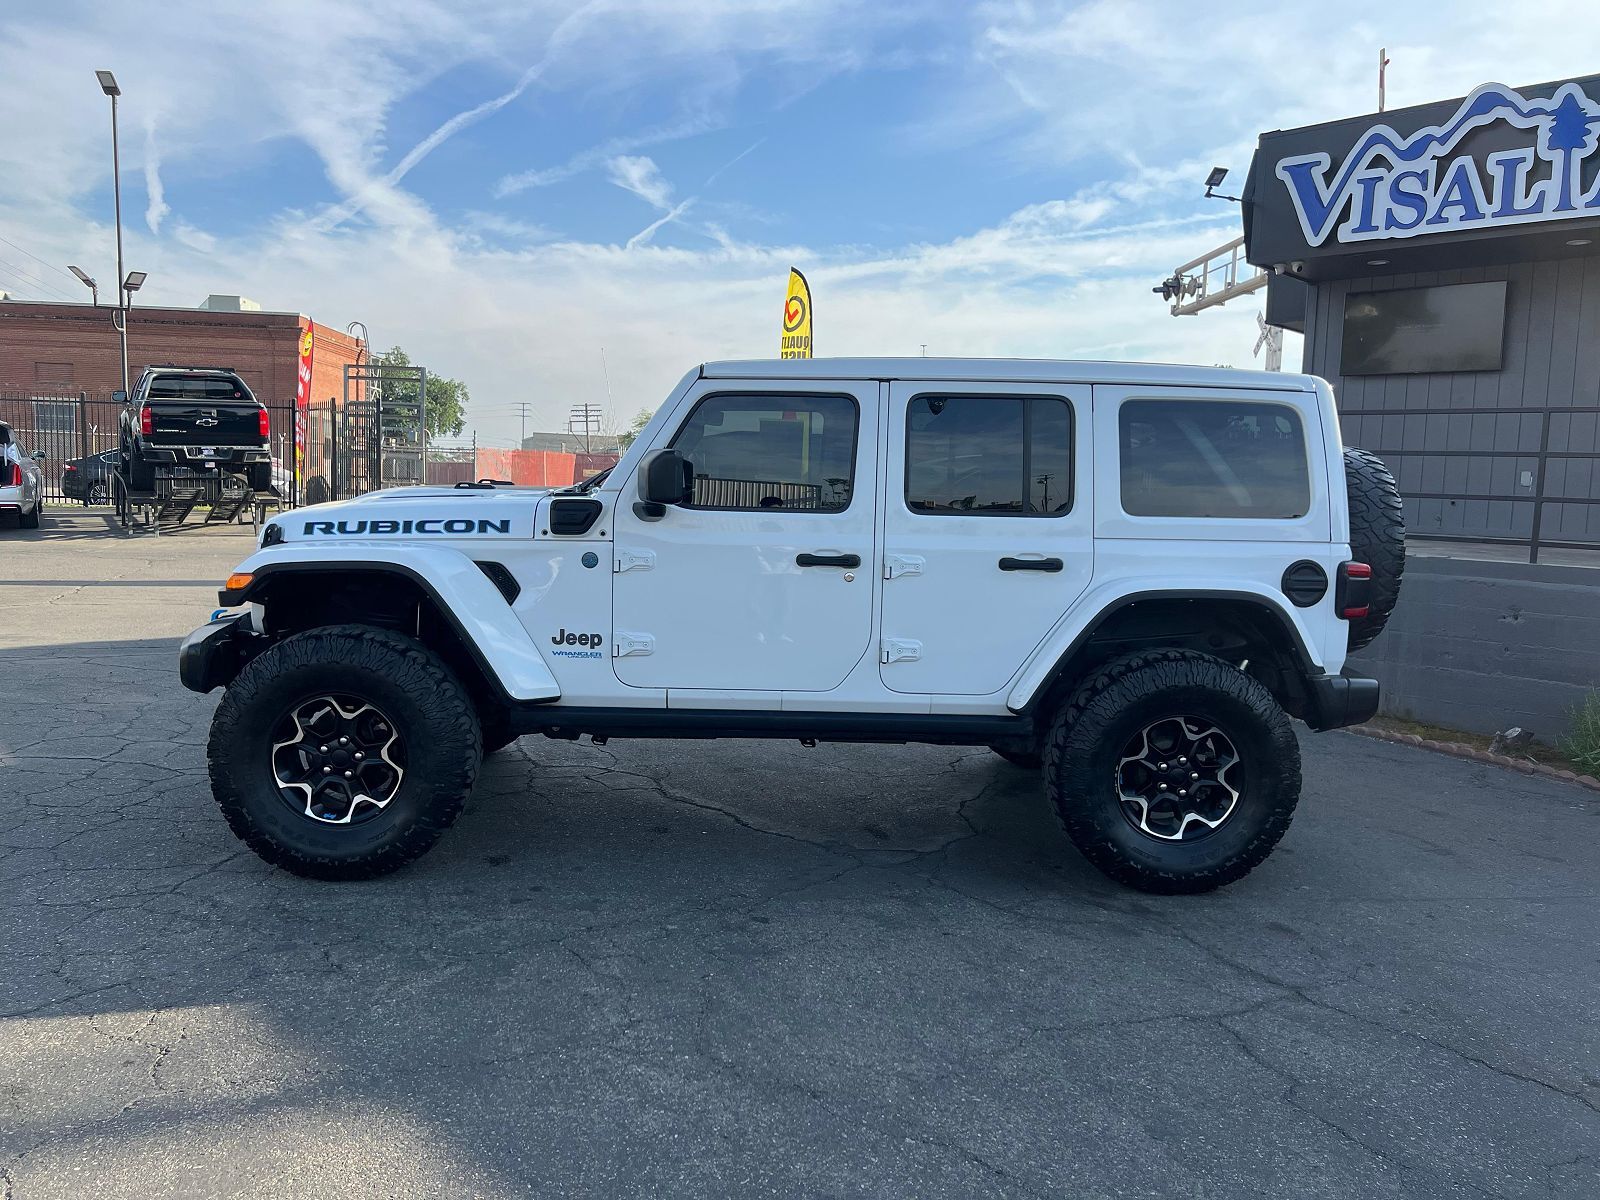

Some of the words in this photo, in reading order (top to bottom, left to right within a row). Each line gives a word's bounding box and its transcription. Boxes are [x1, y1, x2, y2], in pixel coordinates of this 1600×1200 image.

[1282, 93, 1600, 237] VISALI
[303, 519, 511, 535] RUBICON
[551, 628, 603, 649] Jeep
